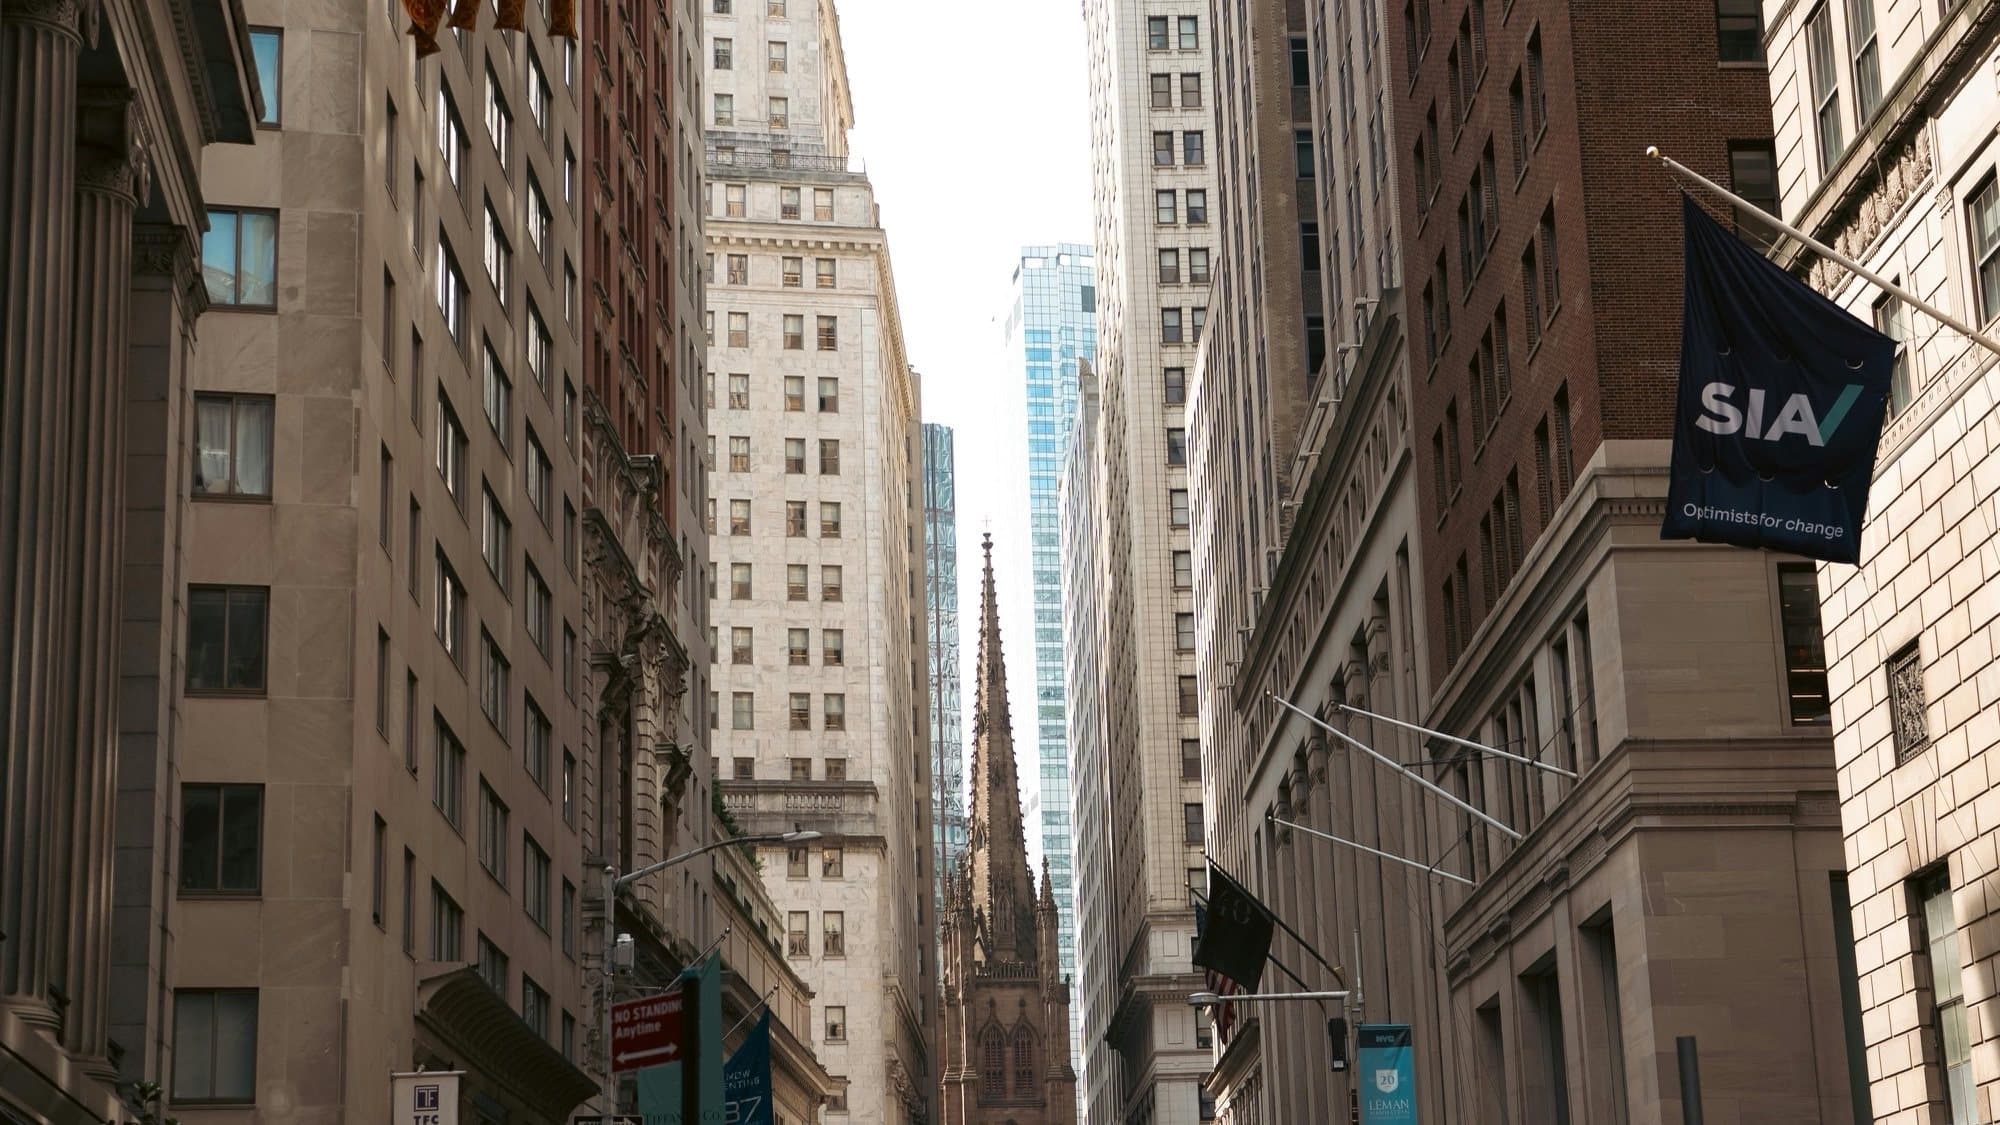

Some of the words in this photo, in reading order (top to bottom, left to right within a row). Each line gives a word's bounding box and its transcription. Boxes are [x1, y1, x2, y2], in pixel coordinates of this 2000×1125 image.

[1785, 519, 1844, 539] change
[615, 1009, 630, 1023] NO
[615, 1021, 661, 1039] Anytime
[1379, 1075, 1394, 1085] 20
[413, 1115, 439, 1125] TFC
